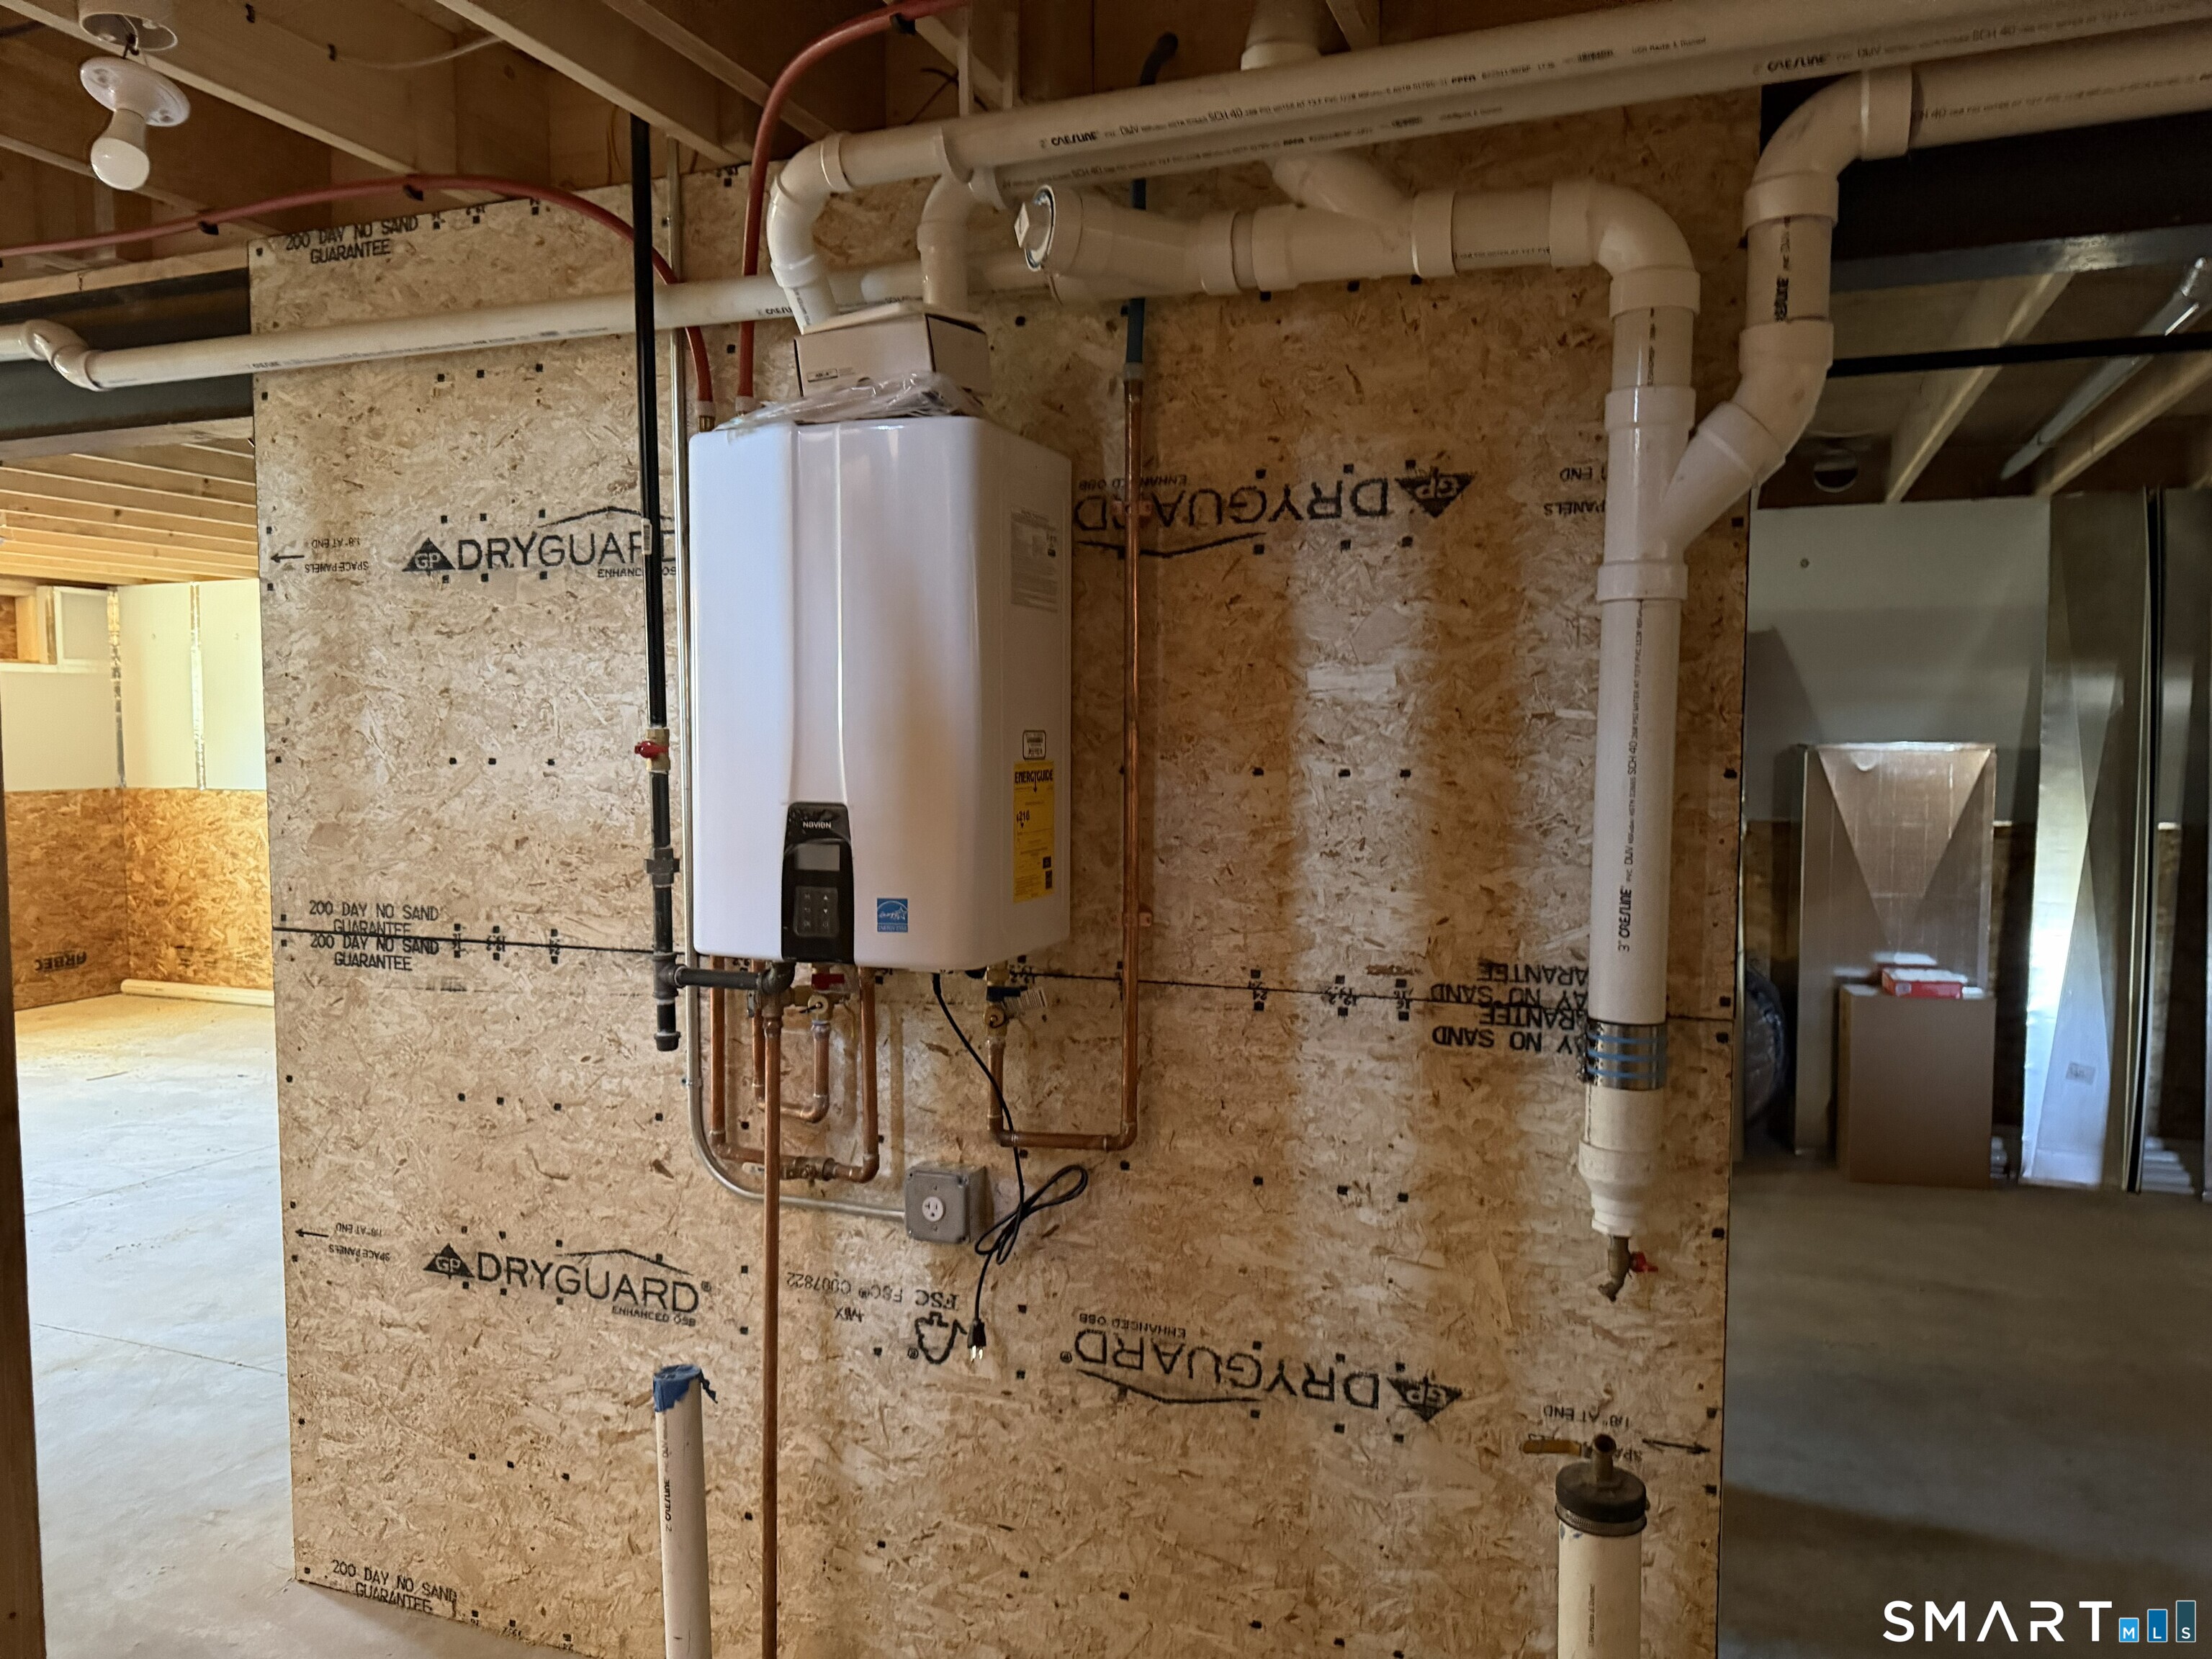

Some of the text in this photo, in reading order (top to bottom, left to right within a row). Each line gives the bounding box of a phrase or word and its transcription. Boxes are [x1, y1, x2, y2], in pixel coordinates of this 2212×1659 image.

[286, 216, 419, 251] 200 DAY NO SAND
[310, 238, 391, 264] GUARANTEE
[1111, 474, 1188, 489] ENHANED
[1560, 467, 1593, 482] END
[1074, 476, 1390, 531] DRYGUAD
[311, 539, 331, 549] END
[331, 538, 343, 548] AT
[305, 561, 369, 574] SPACE PANELS
[414, 552, 442, 570] GP
[597, 567, 646, 577] ENHANC
[1629, 740, 1638, 755] 40
[1627, 757, 1637, 775] SCH
[1014, 768, 1053, 786] ENERGYGUIDE
[1624, 845, 1633, 866] DWV
[309, 900, 439, 922] 200 DAY NO SAND
[1618, 886, 1632, 939] CRESLINE
[333, 918, 413, 936] GUARANTEE
[310, 934, 440, 956] 200 DAY NO SAND
[333, 951, 413, 972] GUARANTEE
[1475, 961, 1590, 987] ARANTEE
[1430, 984, 1590, 1014] AY NO SAND
[1478, 1005, 1577, 1032] RANTEE
[1431, 1025, 1496, 1048] SAND
[1509, 1030, 1543, 1052] NO
[335, 1223, 354, 1234] END
[354, 1225, 367, 1236] AT
[328, 1244, 390, 1262] SPACE PANELS
[434, 1255, 461, 1273] GP
[914, 1289, 961, 1311] FSC
[611, 1305, 670, 1323] ENHANCED
[1111, 1318, 1187, 1339] ENHANCED
[1543, 1405, 1575, 1421] END
[1577, 1411, 1600, 1424] AT
[332, 1560, 458, 1604] 200 DAY NO SAND
[356, 1582, 433, 1614] GUARANTEE
